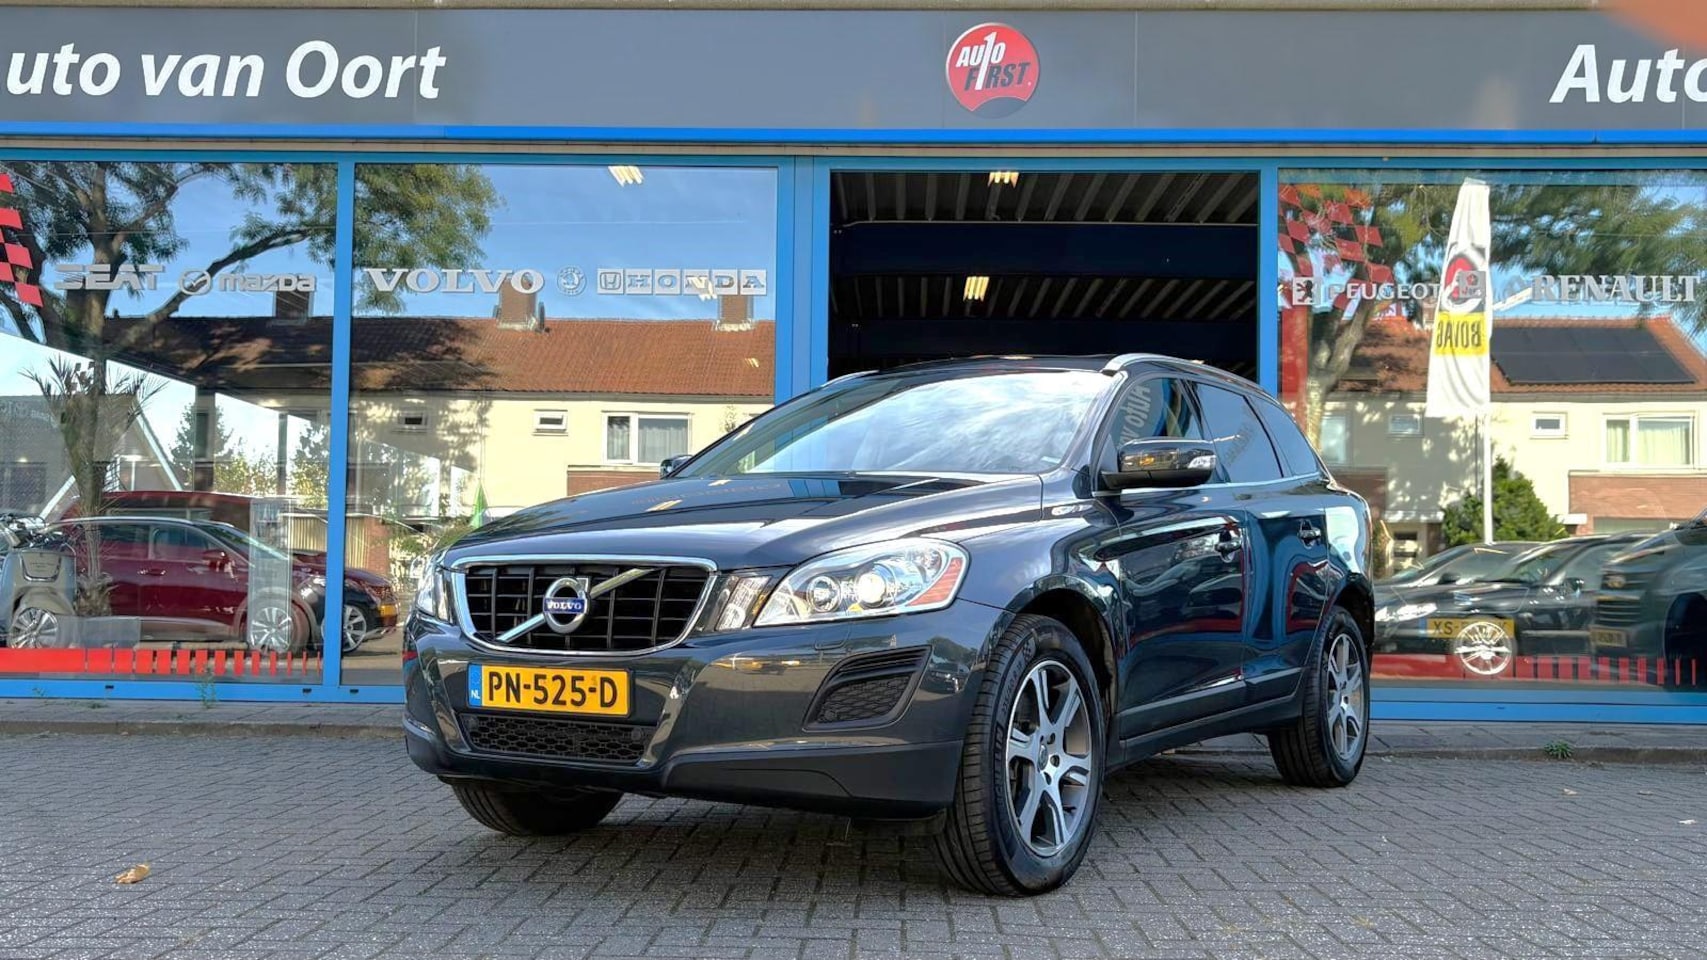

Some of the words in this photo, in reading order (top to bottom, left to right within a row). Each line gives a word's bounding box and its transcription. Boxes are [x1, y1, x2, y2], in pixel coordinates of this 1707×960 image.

[141, 54, 265, 97] van
[285, 40, 447, 99] Oort
[55, 264, 164, 290] SEAT
[363, 268, 545, 294] VOLVO
[627, 272, 766, 290] HONDA
[1531, 274, 1700, 302] RENAULT
[1328, 282, 1442, 300] PEUGEOT
[546, 600, 582, 610] VOLVO
[470, 689, 480, 699] NL
[488, 671, 618, 708] PN-525-D
